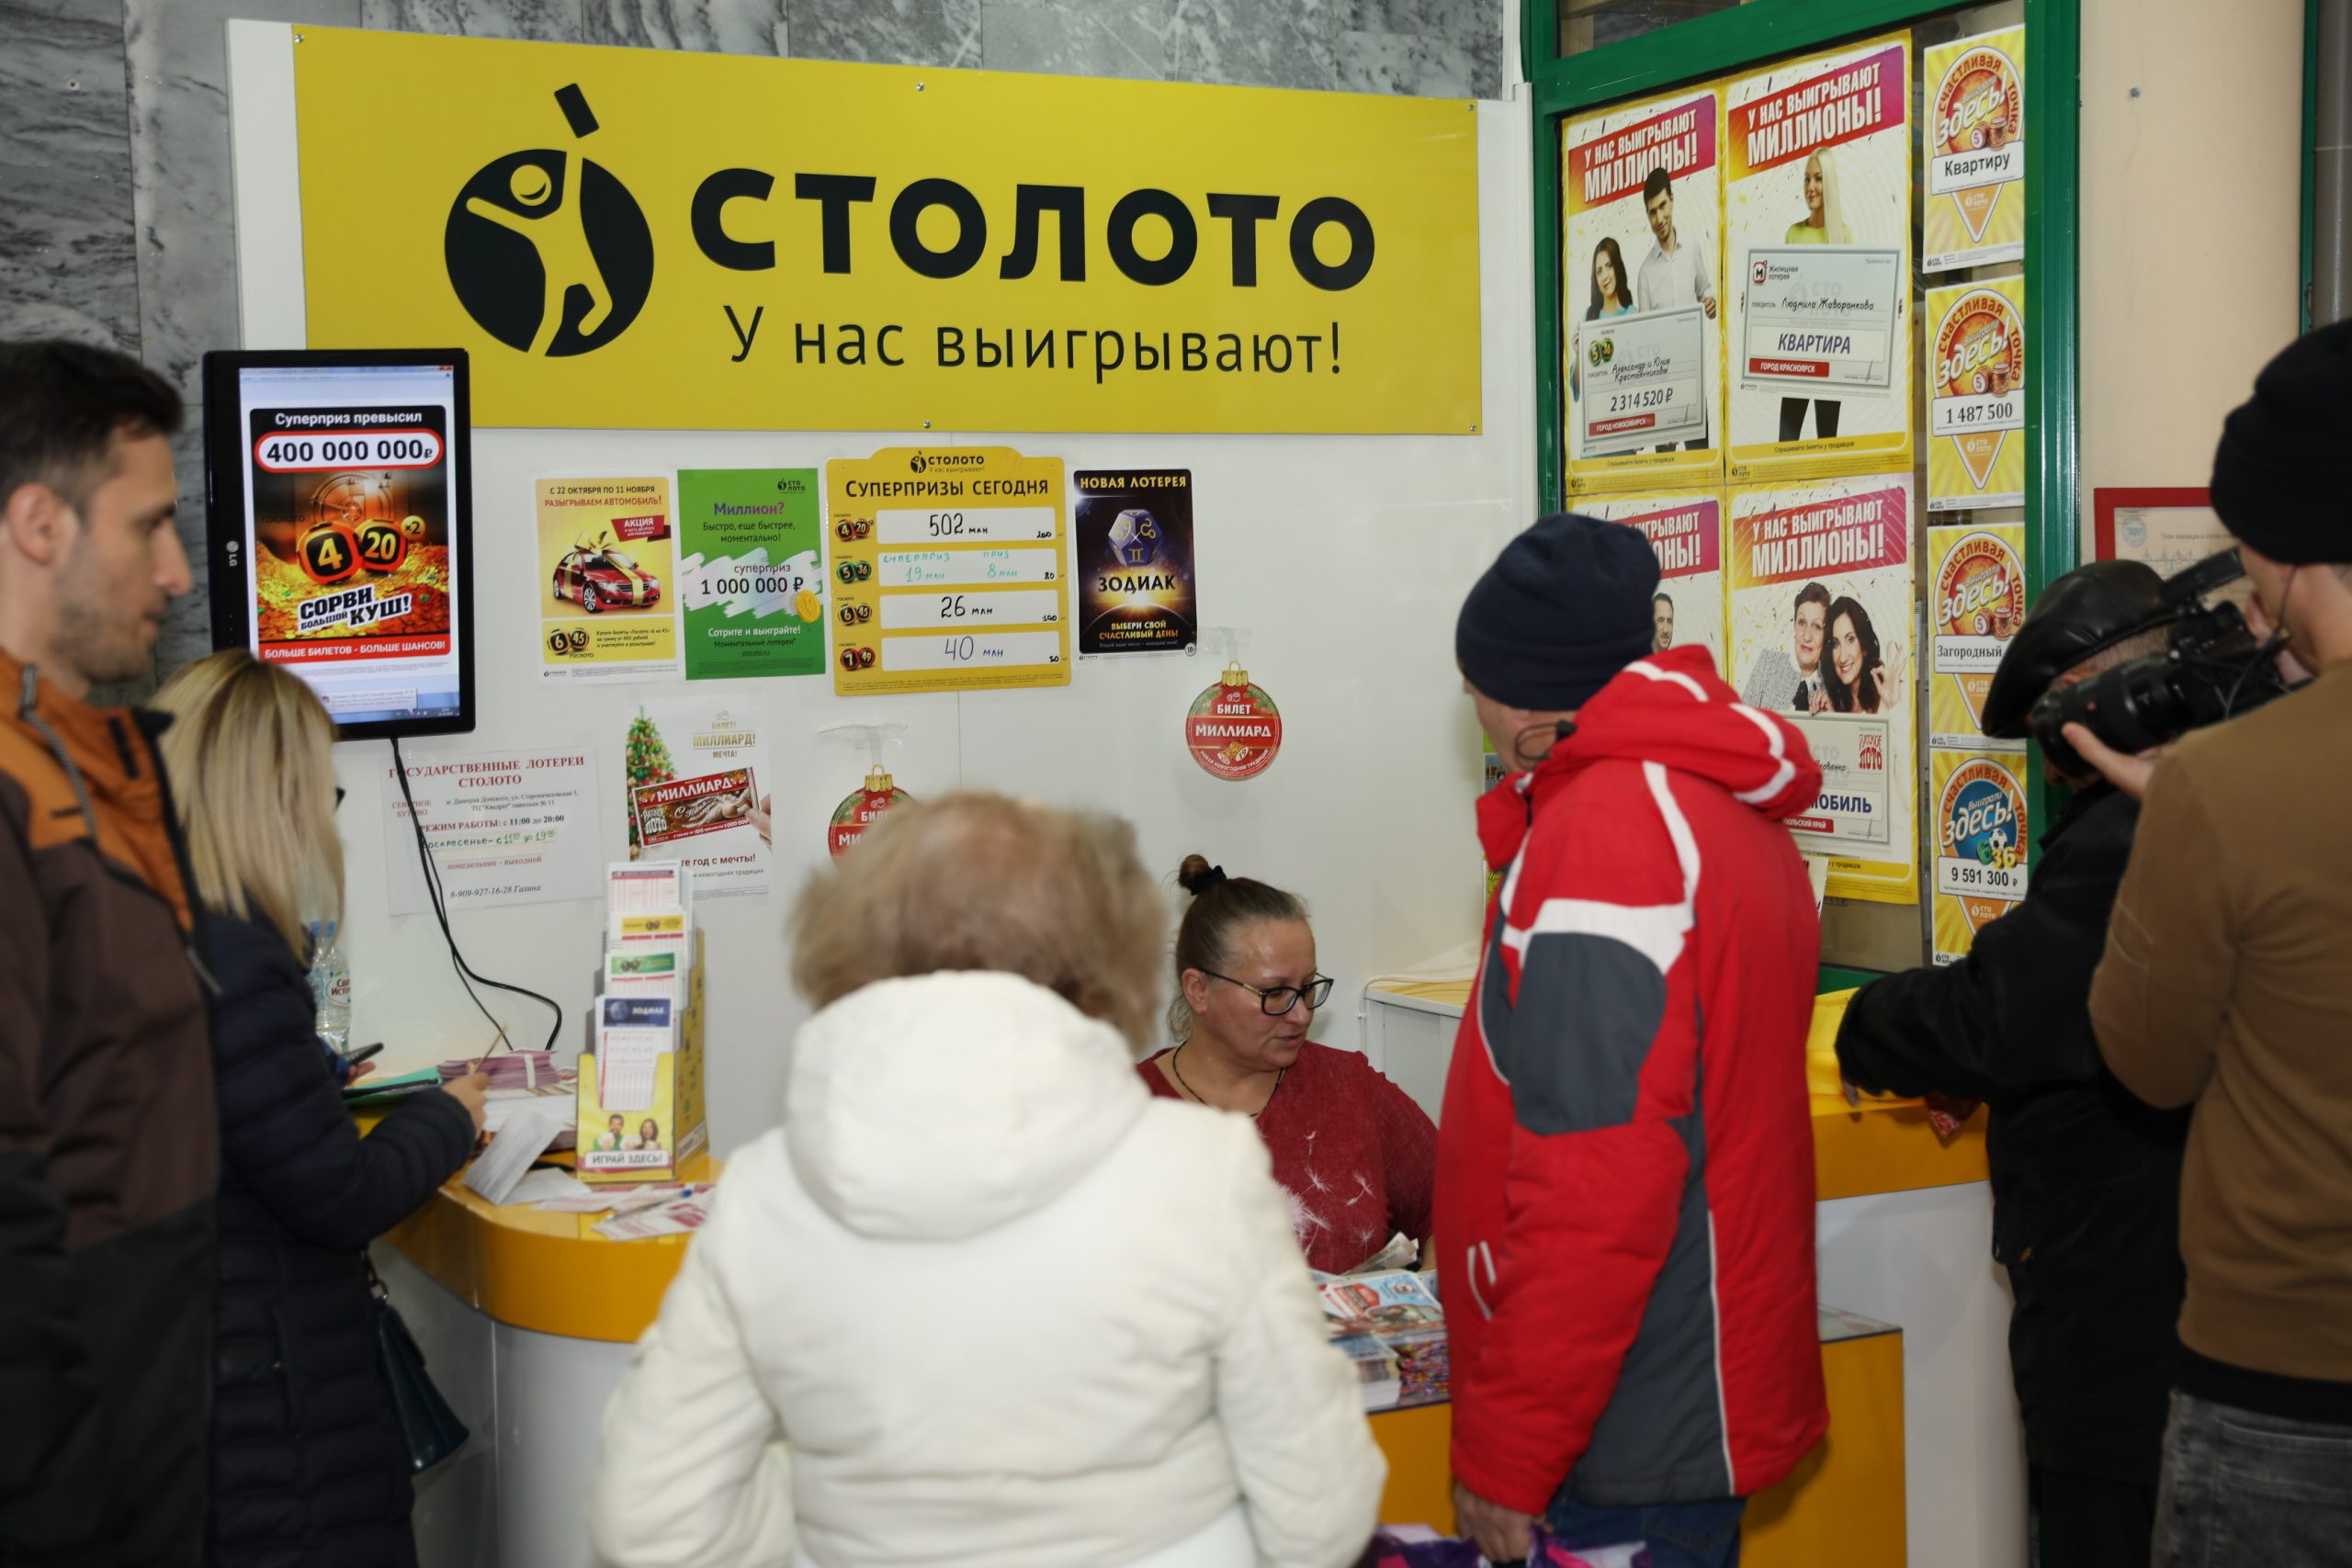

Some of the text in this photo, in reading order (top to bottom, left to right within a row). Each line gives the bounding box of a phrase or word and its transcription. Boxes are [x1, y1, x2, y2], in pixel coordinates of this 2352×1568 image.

[1747, 62, 1881, 130] У НАС ВЫИГРЫВАЮТ
[1937, 70, 2007, 148] здесь!
[1747, 87, 1882, 167] МИЛЛИОНЫ!
[1585, 109, 1696, 168] У НАС ВЫИГРЫВАЮТ
[1585, 132, 1698, 203] МИЛЛИОНЫ!
[1944, 152, 2010, 177] Квартиру
[689, 167, 1376, 292] СТОЛОТО
[1768, 273, 1790, 281] лотерея
[1769, 265, 1798, 274] Жилищная
[1781, 298, 1815, 311] Людмила
[1939, 297, 2004, 354] счастливая
[723, 304, 1344, 384] У нас выигрывают!
[1778, 333, 1851, 355] КВАРТИРА
[1937, 315, 2011, 389] здесь!
[1760, 362, 1815, 374] ГОРОД КРАСНОЯРСК
[1611, 389, 1663, 412] 2 314 520
[276, 412, 422, 427] Суперприз превысил
[1947, 401, 2013, 424] 1 487 500
[1596, 418, 1646, 433] ГОРОД НОВОСИБИРСК
[266, 441, 368, 462] 400 000
[928, 455, 985, 465] СТОЛОТО
[845, 479, 1048, 498] СУПЕРПРИЗЫ СЕГОДНЯ
[1080, 476, 1187, 489] НОВАЯ ЛОТЕРЕЯ
[545, 495, 662, 507] РАЗЫГРЫВАЕМ АВТОМОБИЛЬ!
[714, 502, 785, 515] Миллион?
[625, 517, 654, 528] АКЦИЯ
[703, 521, 796, 532] Быстро, еще быстрее,
[929, 513, 964, 536] 502
[1753, 499, 1883, 543] У НАС ВЫИГРЫВАЮТ
[720, 534, 781, 542] моментально!
[318, 532, 396, 570] 4 20
[1752, 524, 1884, 578] МИЛЛИОНЫ!
[734, 564, 791, 575] суперприз
[907, 564, 996, 582] 19 8
[1940, 540, 2005, 592] счастливая
[701, 577, 787, 595] 1 000 000
[1098, 576, 1176, 594] ЗОДИАК
[1939, 560, 2012, 626] здесь!
[300, 587, 373, 619] СОРВИ
[941, 595, 966, 618] 26
[300, 595, 411, 630] БОЛЬШОЙ КУШ!
[707, 628, 742, 638] Сотрите
[753, 625, 801, 636] выиграйте!
[1112, 620, 1166, 630] ВЫБЕРИ СВОЙ
[555, 632, 585, 649] 6 45
[1099, 630, 1178, 639] СЧАСТЛИВЫЙ ДЕНЬ!
[265, 641, 446, 659] БОЛЬШЕ БИЛЕТОВ БОЛЬШЕ ШАНСОВ!
[944, 636, 973, 660] 40
[1938, 645, 2003, 660] Загородный
[1216, 705, 1250, 714] БИЛЕТ
[693, 733, 756, 747] МИЛЛИАРД!
[1195, 725, 1272, 737] МИЛЛИАРД
[526, 756, 585, 770] ЛОТЕРЕИ
[712, 750, 737, 759] МЕЧТА!
[1859, 747, 1883, 771] ЛОТО
[458, 775, 522, 788] СТОЛОТО
[656, 777, 732, 802] МИЛЛИАРД
[1944, 765, 2007, 813] счастливая
[391, 799, 431, 809] СЕВРНОЕ
[397, 809, 428, 818] БУТВО
[1942, 789, 2015, 848] здесь!
[419, 825, 456, 833] РЕЖИМ
[458, 819, 502, 830] РАБОТЫ:
[510, 818, 530, 826] 11:00
[543, 815, 564, 823] 20:00
[1813, 820, 1826, 829] КРАЙ
[447, 855, 542, 870] понедельник выходной
[693, 857, 709, 867] год
[720, 853, 756, 865] мечты!
[1951, 867, 2008, 886] 9 591 300
[450, 885, 541, 898] 8-909-927-16-28 Галина
[632, 1007, 664, 1015] ЗОДИАК
[593, 1152, 662, 1164] ИГРАЙ ЗДЕСЬ!
